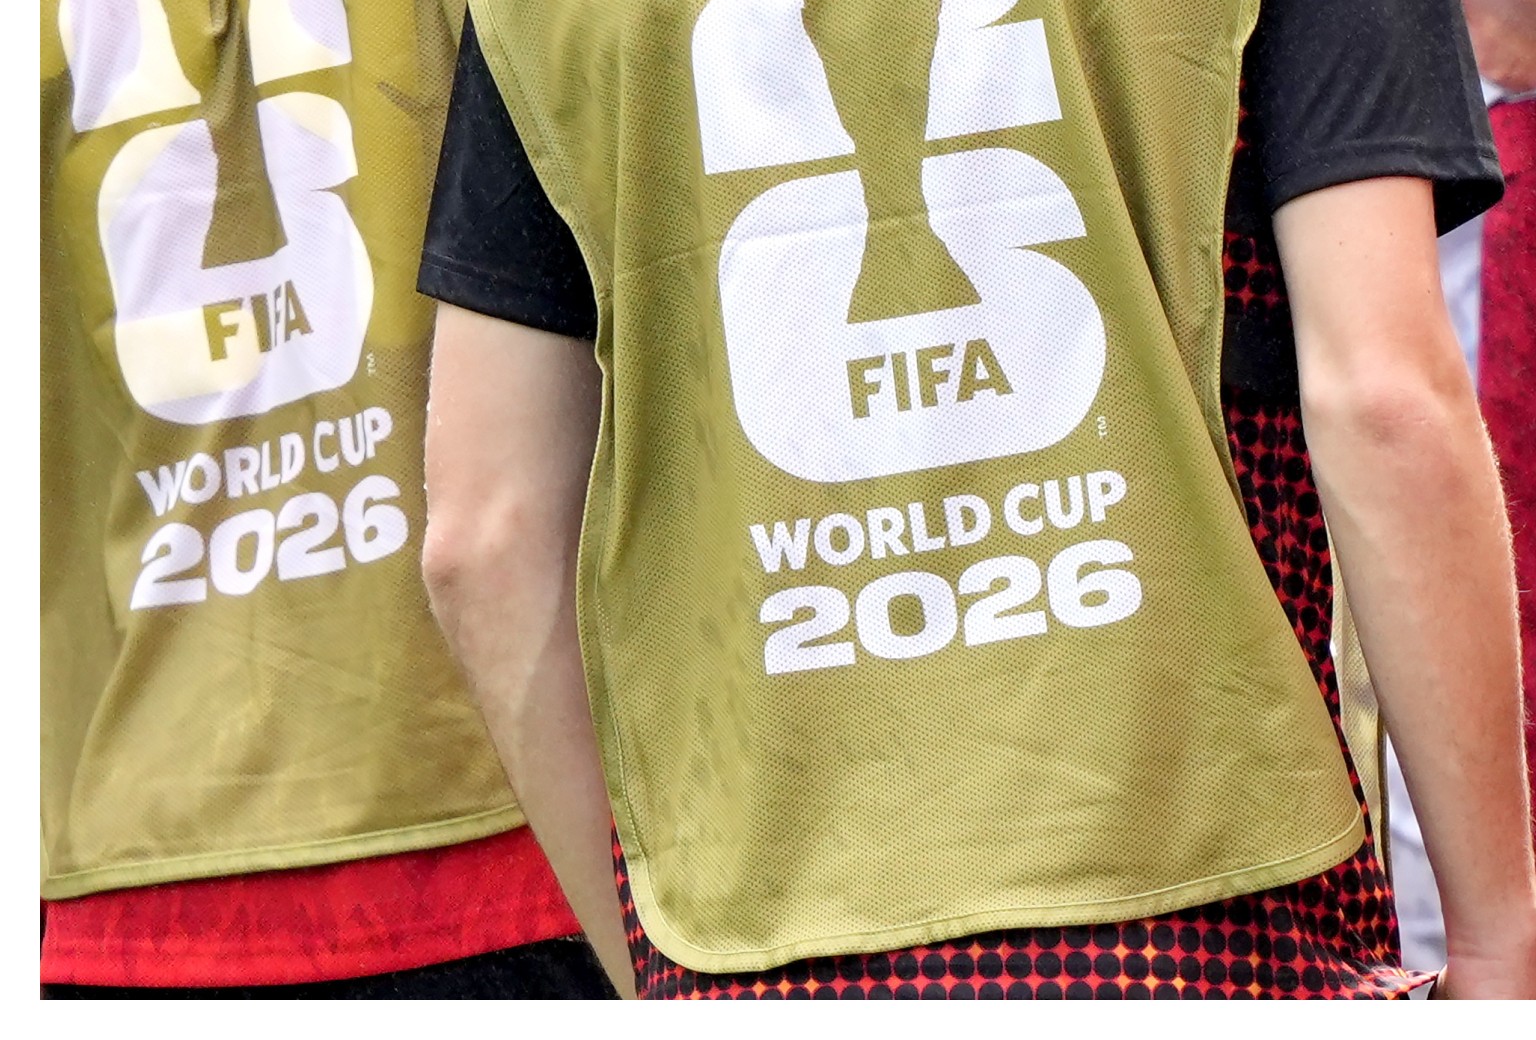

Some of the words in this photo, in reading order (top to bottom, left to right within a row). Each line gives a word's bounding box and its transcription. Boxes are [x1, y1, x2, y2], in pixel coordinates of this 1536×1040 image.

[200, 280, 311, 362] FIFA
[846, 338, 1013, 419] FIFA
[135, 433, 304, 517] WORLD
[313, 406, 393, 465] CUP
[130, 474, 409, 611] 2026
[749, 494, 991, 573] WORLD
[1004, 470, 1126, 535] CUP
[759, 539, 1142, 676] 2026
